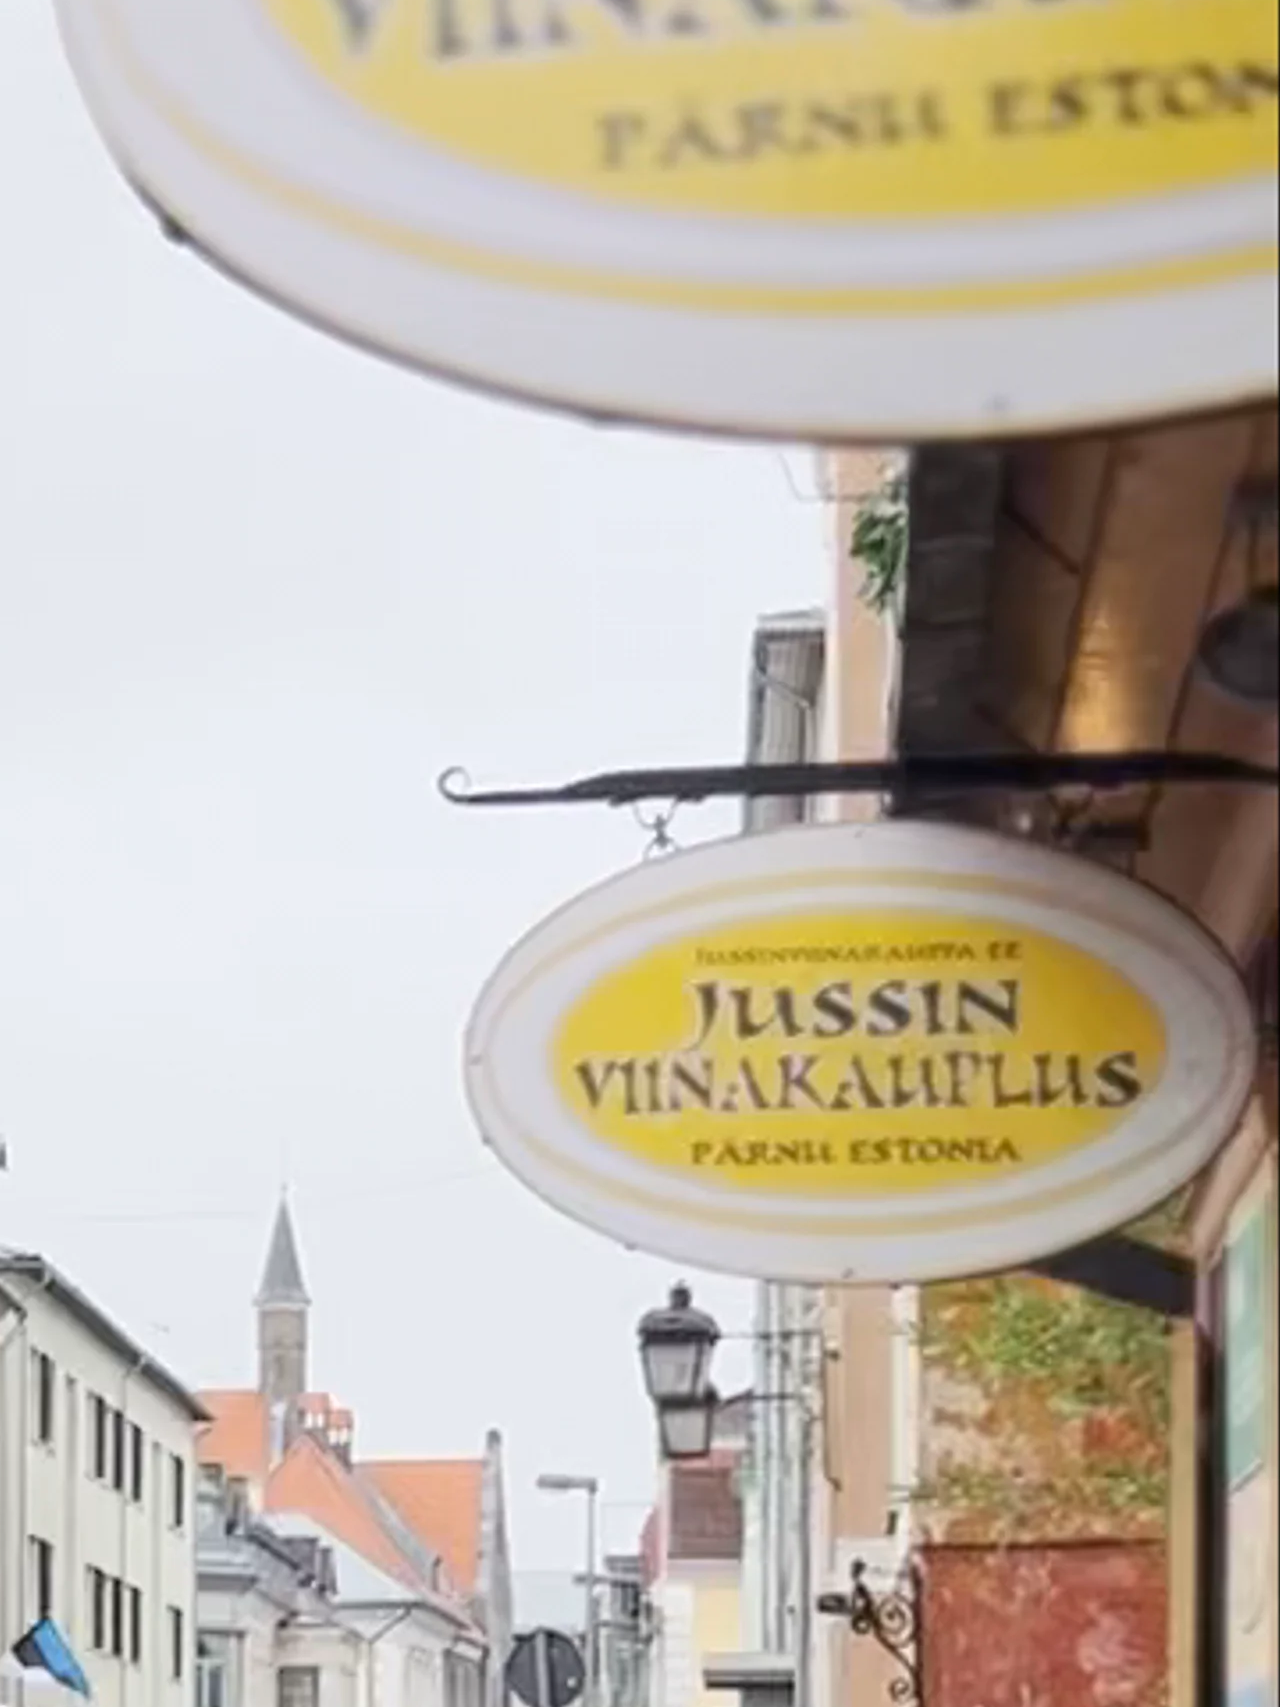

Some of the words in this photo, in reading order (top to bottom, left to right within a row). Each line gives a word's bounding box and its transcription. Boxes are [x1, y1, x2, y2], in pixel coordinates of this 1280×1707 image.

[690, 979, 1019, 1050] JUSSIN
[575, 1050, 1141, 1114] VIINAKAUPLUS
[849, 1137, 1020, 1166] ESTONIA
